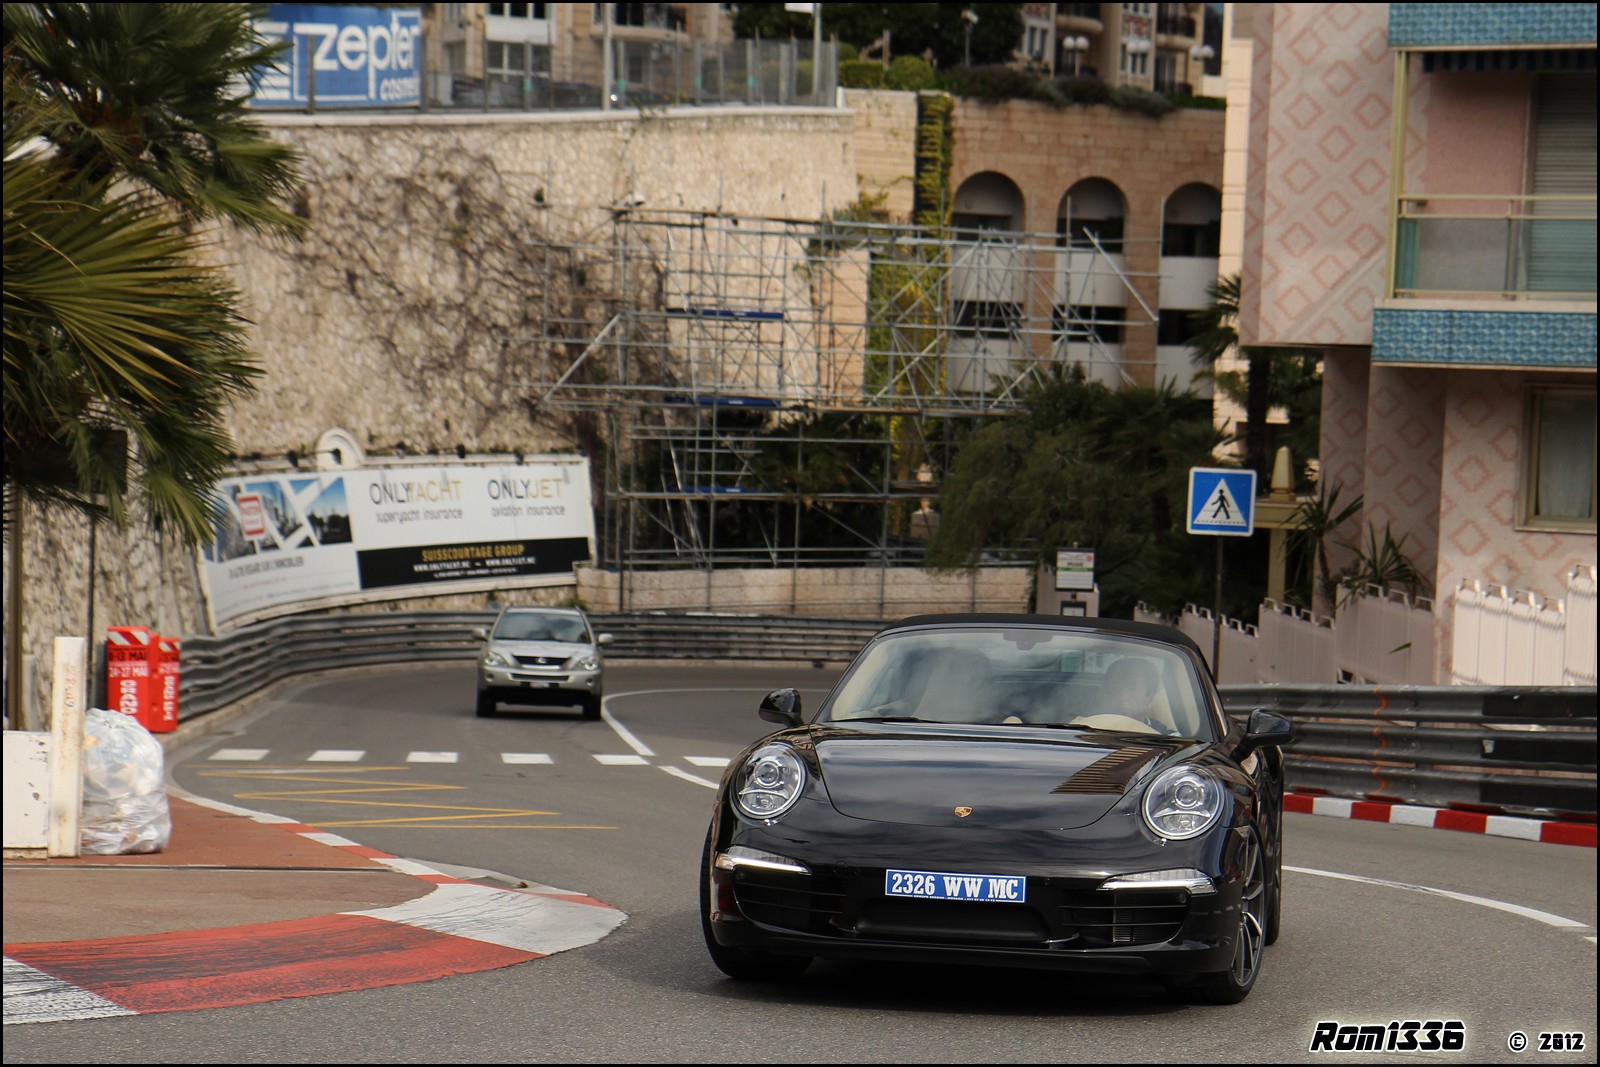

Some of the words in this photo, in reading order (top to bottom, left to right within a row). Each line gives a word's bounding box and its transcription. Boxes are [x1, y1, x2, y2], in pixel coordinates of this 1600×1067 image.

[487, 477, 563, 500] ONLYJET
[494, 543, 526, 558] GROUP
[891, 873, 936, 896] 2326
[942, 876, 984, 898] WW
[988, 878, 1019, 900] MC
